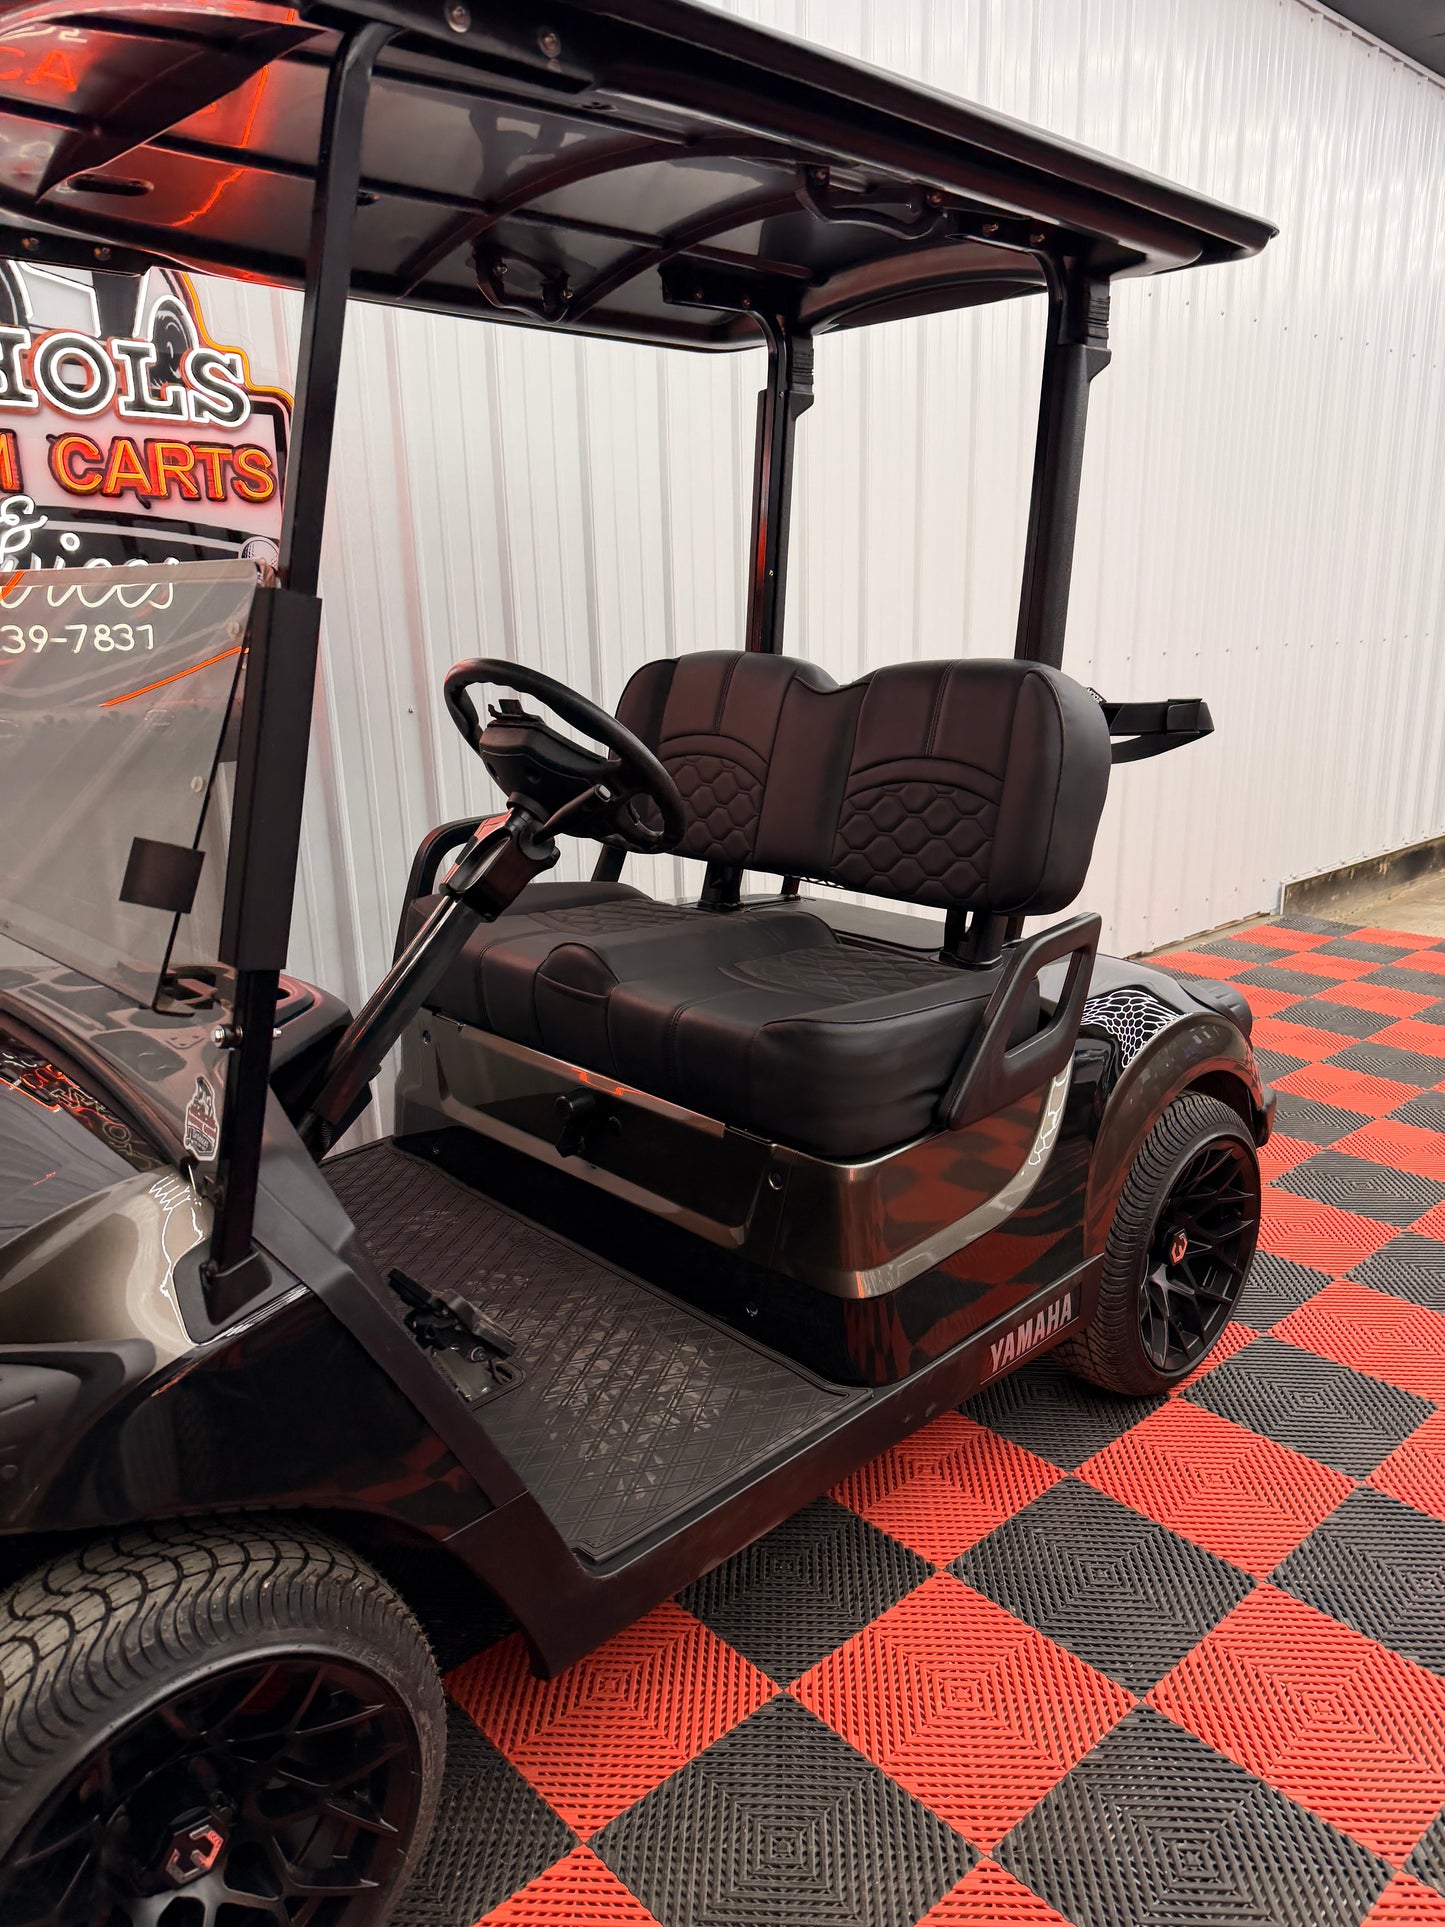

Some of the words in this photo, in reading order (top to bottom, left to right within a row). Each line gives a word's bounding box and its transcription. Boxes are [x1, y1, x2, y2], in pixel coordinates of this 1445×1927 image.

[50, 434, 277, 503] CARTS
[0, 623, 154, 654] 39-7831
[990, 1292, 1073, 1374] YAMAHA
